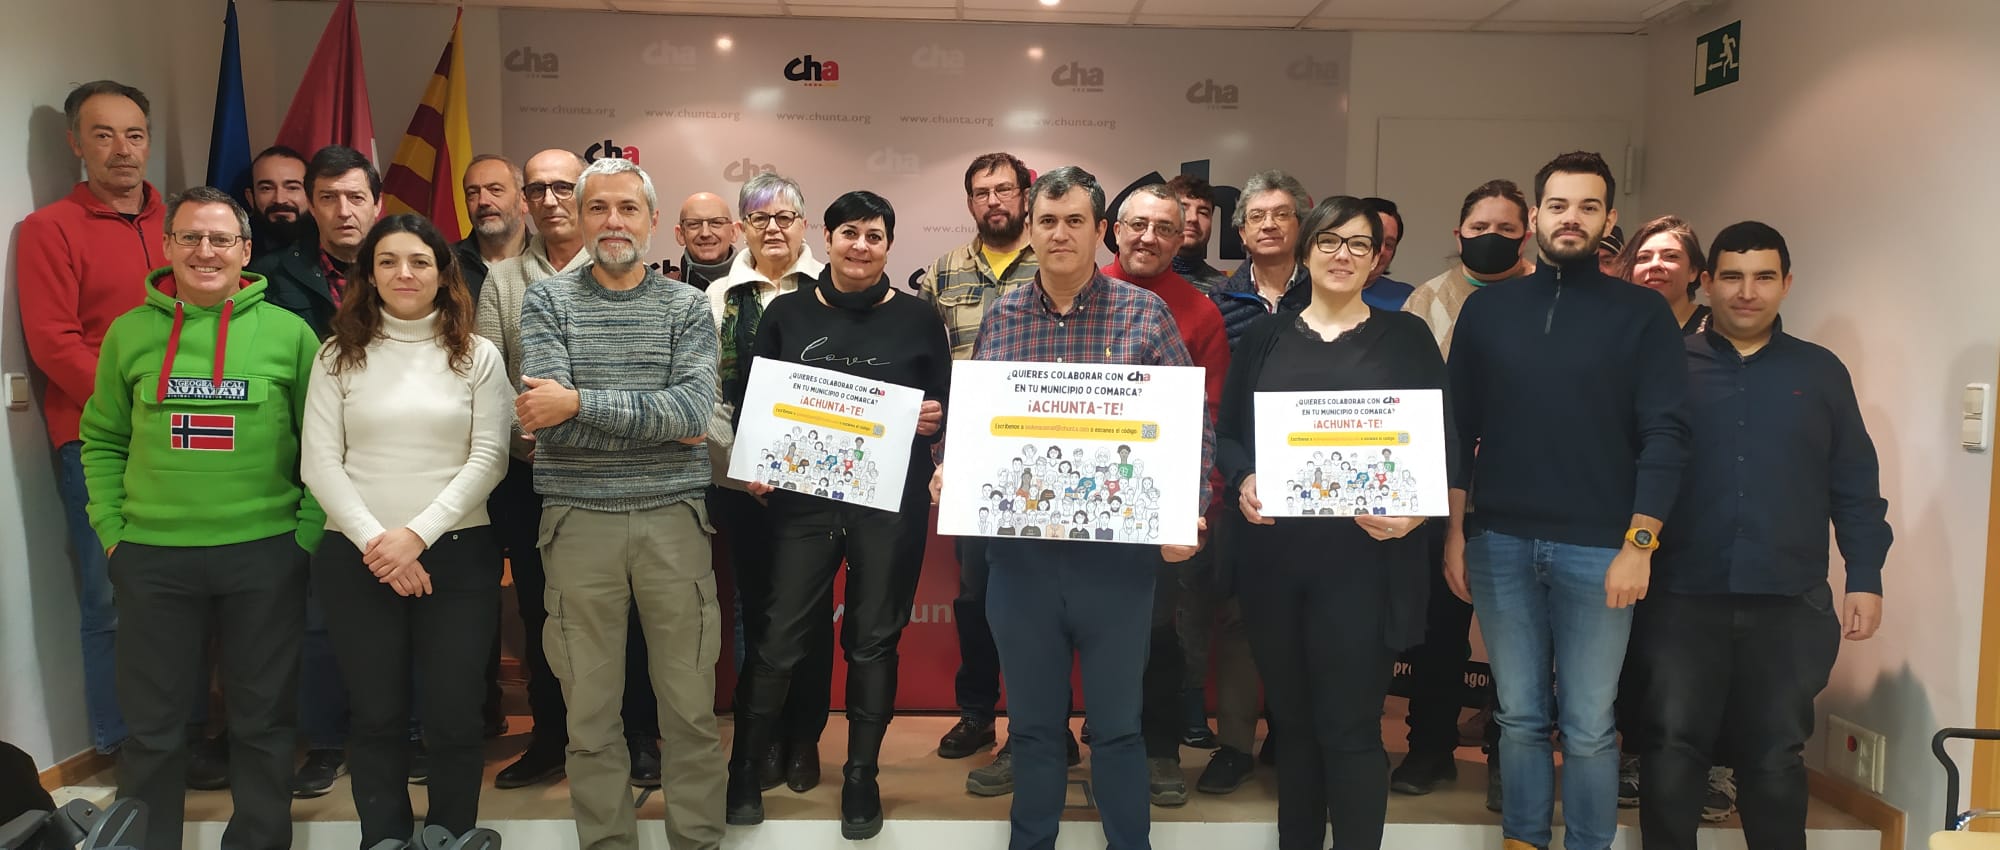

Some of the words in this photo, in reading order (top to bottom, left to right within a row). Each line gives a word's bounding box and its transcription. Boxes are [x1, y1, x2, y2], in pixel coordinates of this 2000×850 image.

[504, 47, 559, 72] cha
[642, 41, 696, 66] cha
[784, 55, 839, 81] cha
[1051, 62, 1104, 87] cha
[1286, 56, 1339, 81] cha
[1186, 79, 1239, 104] cha
[519, 104, 616, 118] www.chunta.org
[645, 108, 741, 121] www.chunta.org
[776, 111, 871, 125] www.chunta.org
[900, 114, 994, 127] www.chunta.org
[800, 336, 891, 366] love
[789, 372, 818, 383] ¿QUIERES
[819, 377, 854, 390] COLABORAR
[854, 385, 868, 393] CON
[869, 386, 886, 396] cha
[1006, 369, 1049, 381] ¿QUIERES
[1050, 370, 1103, 381] COLABORAR
[1105, 372, 1124, 381] CON
[1127, 370, 1151, 382] cha
[793, 382, 802, 390] EN
[802, 384, 810, 392] TU
[810, 385, 840, 398] MUNICIPIO
[845, 393, 879, 405] COMARCA?
[1014, 383, 1026, 393] EN
[1028, 384, 1039, 393] TU
[1040, 384, 1084, 395] MUNICIPIO
[1086, 386, 1092, 395] O
[1094, 386, 1143, 397] COMARCA?
[800, 396, 864, 416] ¡ACHUNTA-TE!
[1028, 399, 1124, 416] ¡ACHUNTA-TE!
[1296, 398, 1326, 407] ¿QUIERES
[1366, 397, 1381, 405] CON
[1382, 396, 1400, 404] cha
[1320, 408, 1353, 416] MUNICIPIO
[1313, 419, 1383, 429] ¡ACHUNTA-TE!
